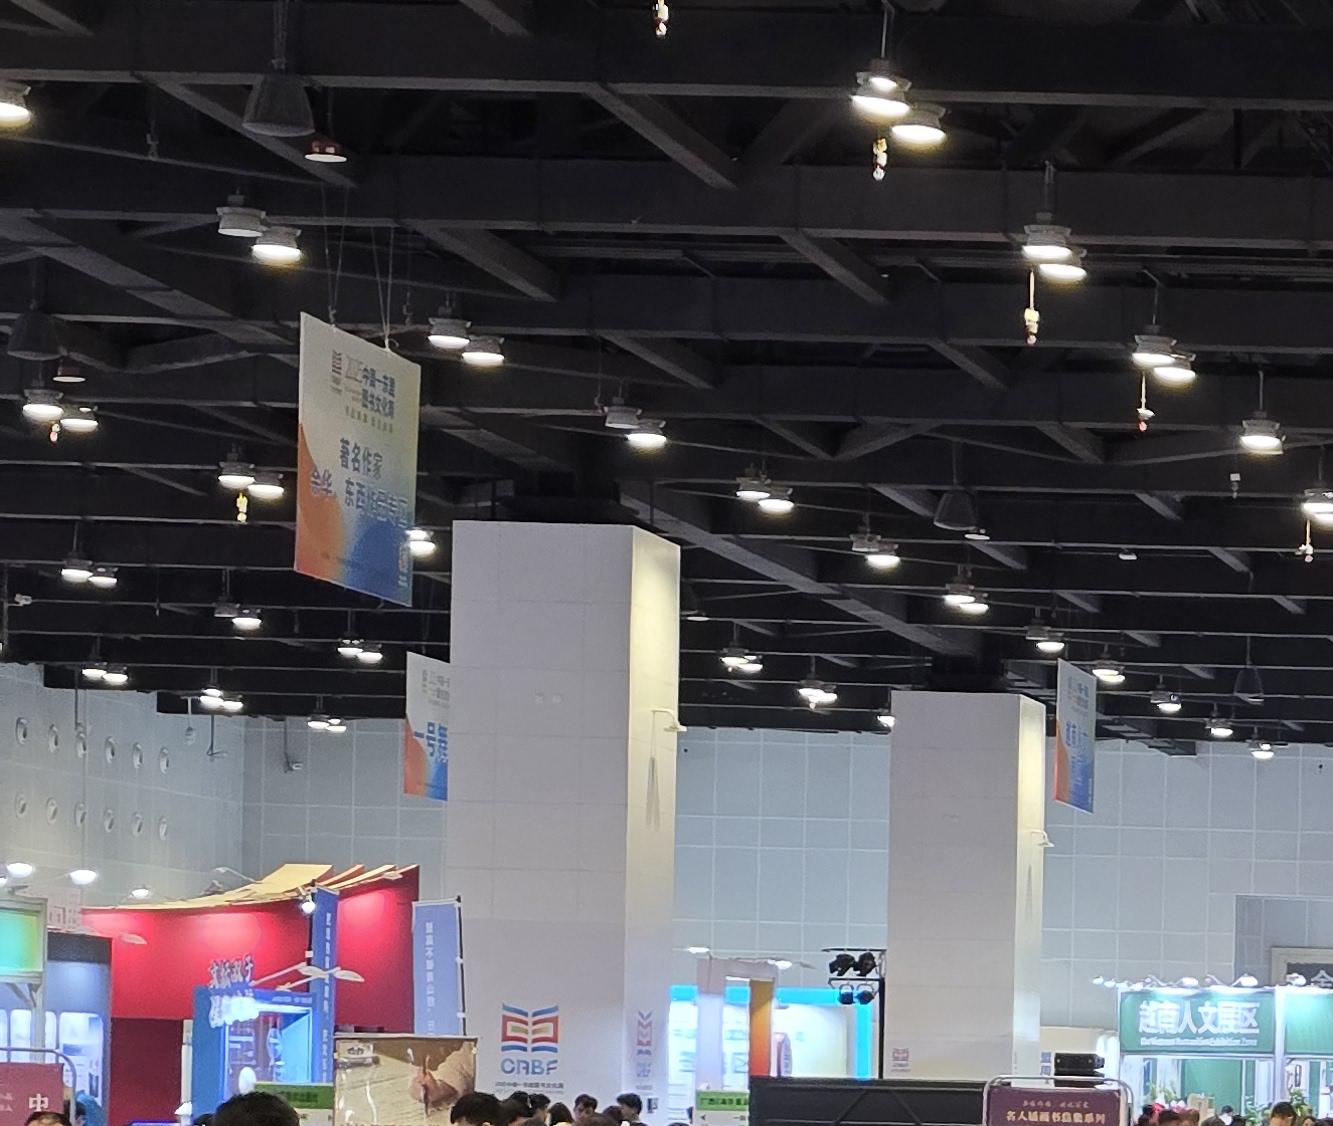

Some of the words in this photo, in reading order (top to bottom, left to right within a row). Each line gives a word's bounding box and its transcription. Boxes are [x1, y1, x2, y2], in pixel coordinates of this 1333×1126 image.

[339, 435, 382, 482] 著名作家
[1138, 1000, 1260, 1034] 越南人文展区
[501, 1058, 558, 1076] CABF
